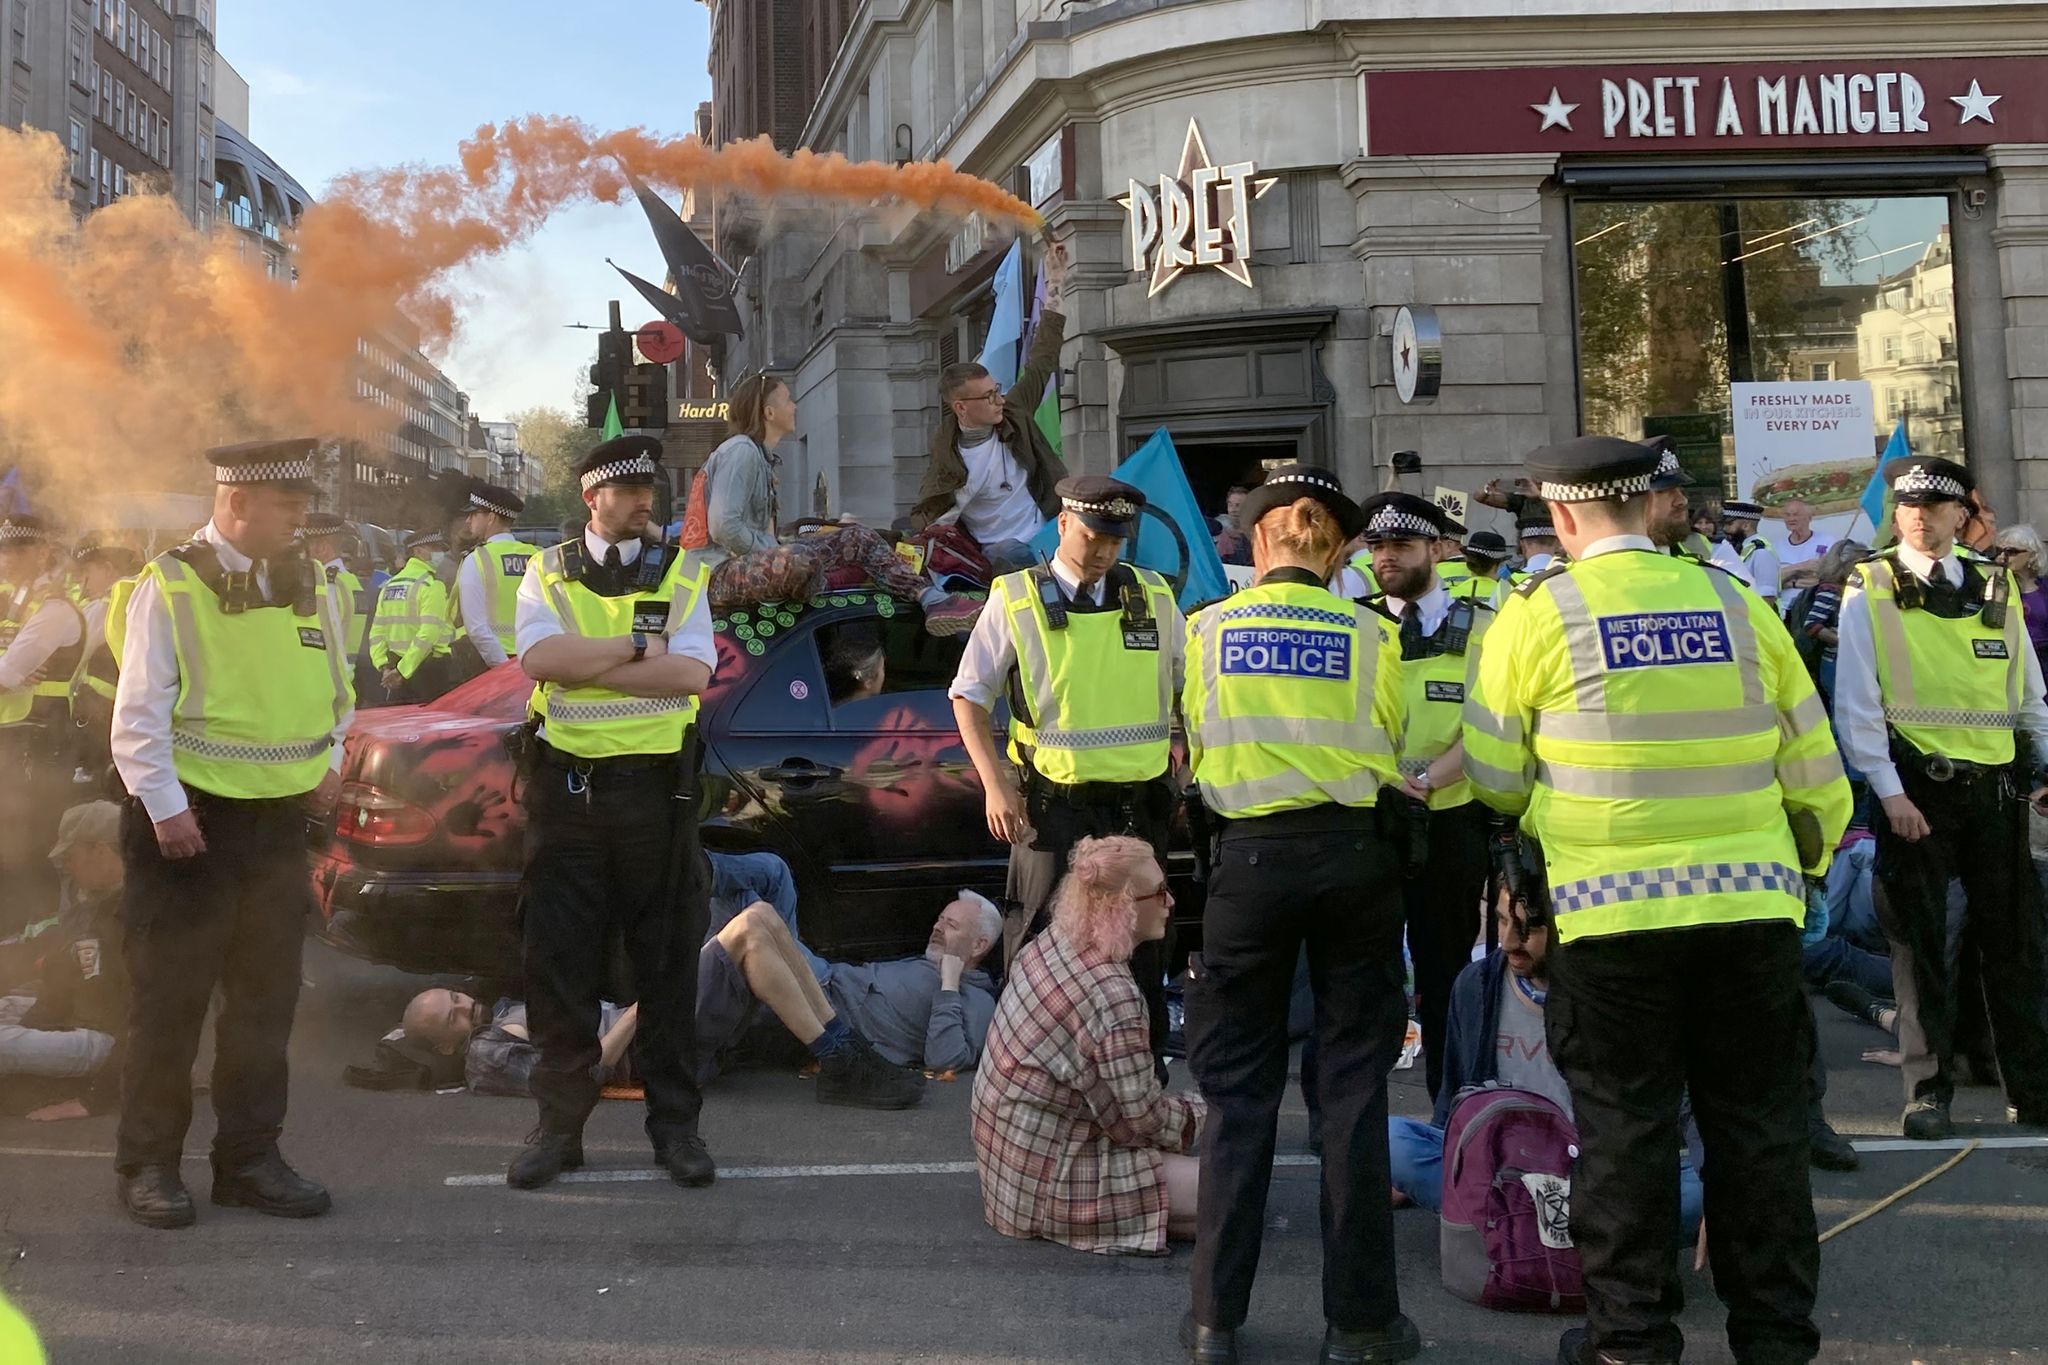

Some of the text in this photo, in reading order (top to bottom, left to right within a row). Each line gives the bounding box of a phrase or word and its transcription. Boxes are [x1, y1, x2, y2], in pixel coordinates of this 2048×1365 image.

[1602, 72, 1929, 138] PRET A MANGER
[1129, 161, 1255, 272] PRET
[1751, 394, 1852, 406] FRESHLY MADE
[678, 403, 717, 418] Hard
[1744, 407, 1862, 420] IN OUR KITCHENS
[1766, 420, 1840, 432] EVERY DAY
[1606, 615, 1718, 634] METROPOLITAN
[1226, 631, 1345, 649] METROPOLITAN
[1610, 631, 1725, 664] POLICE
[1225, 645, 1345, 675] POLICE
